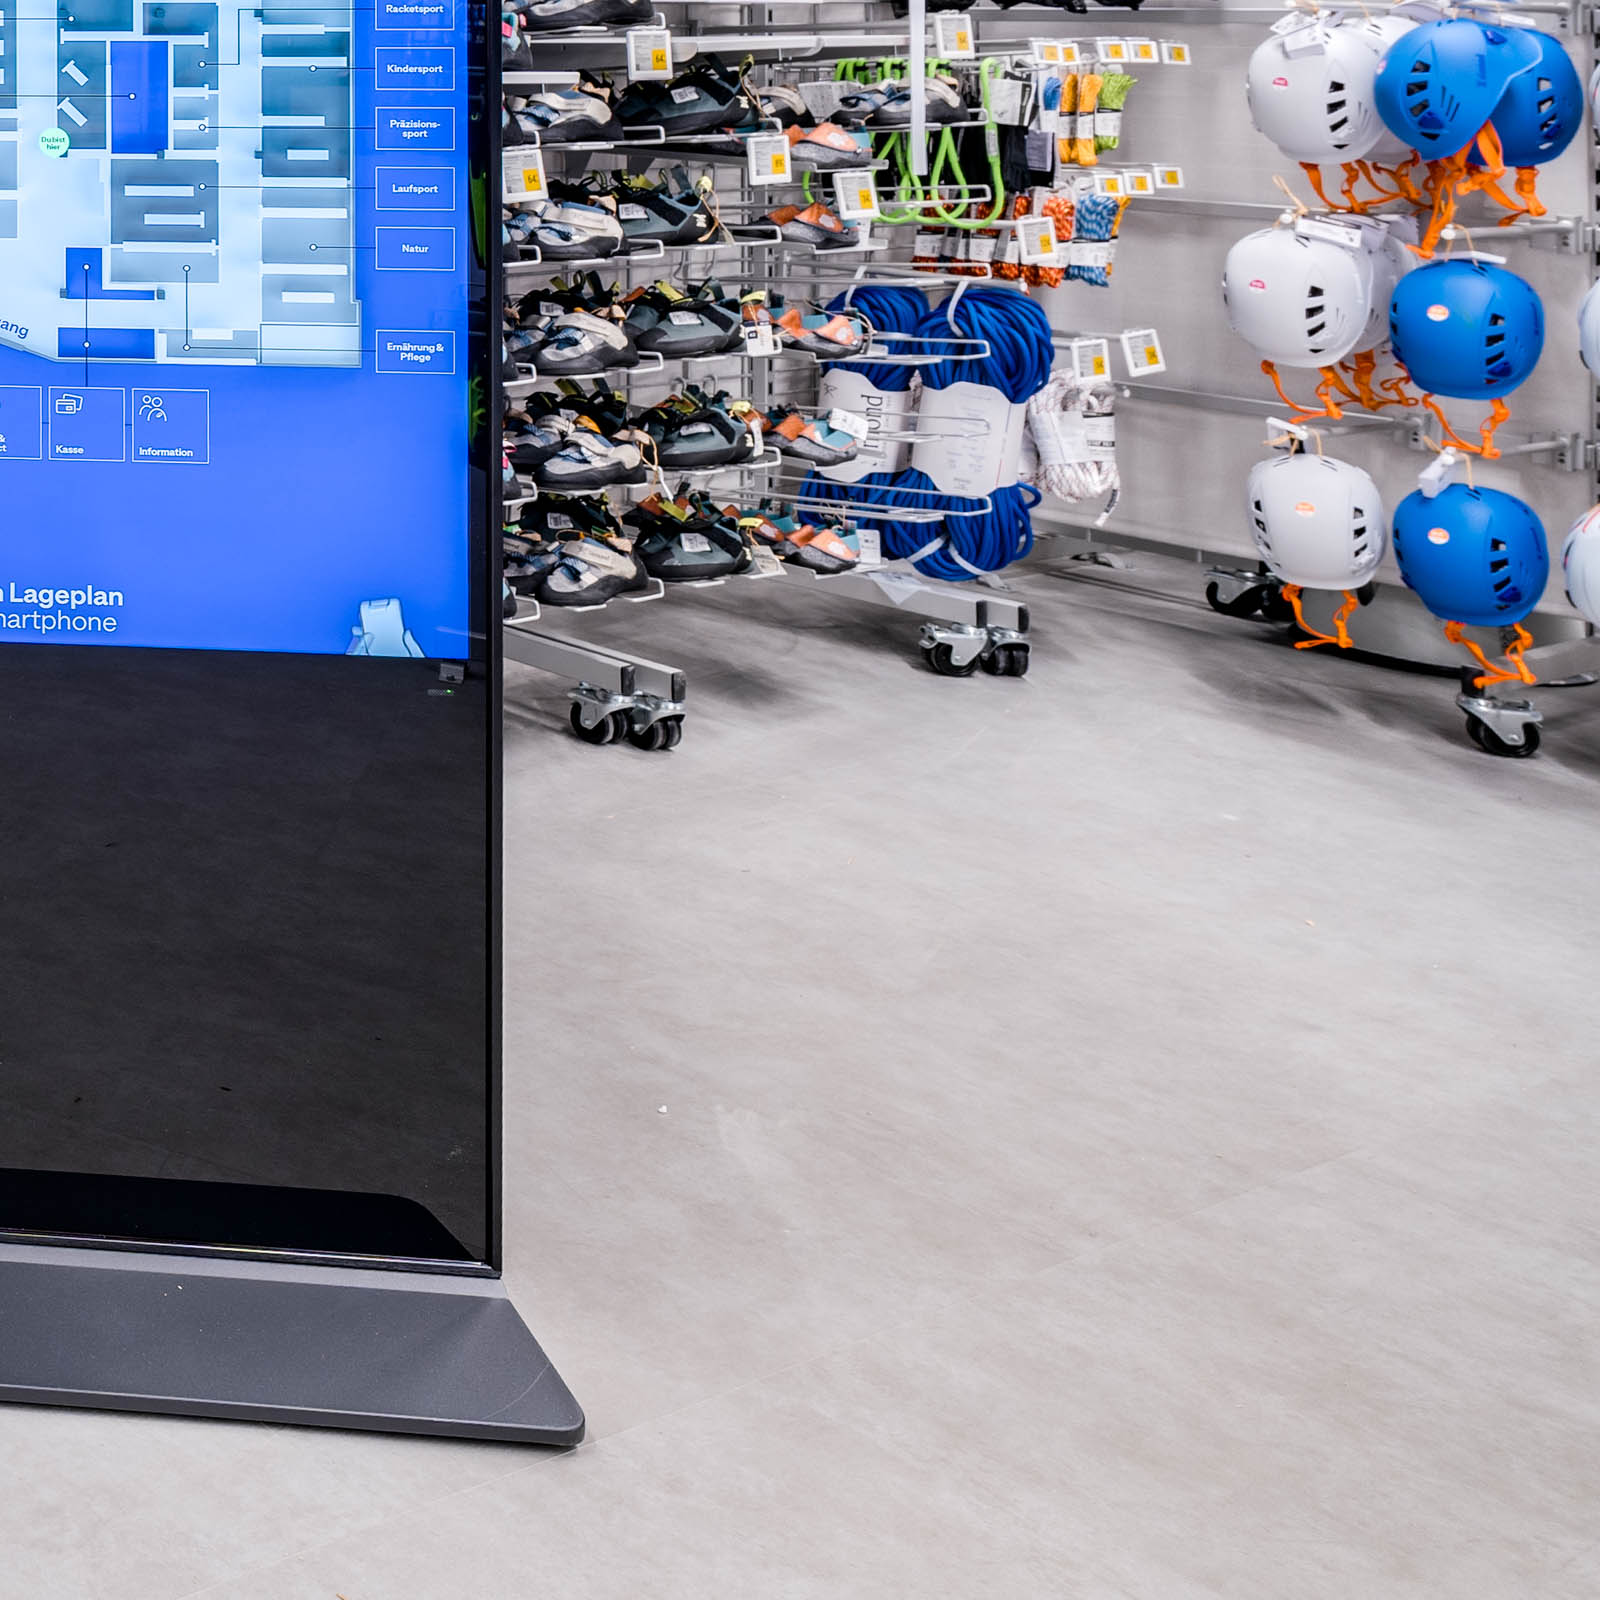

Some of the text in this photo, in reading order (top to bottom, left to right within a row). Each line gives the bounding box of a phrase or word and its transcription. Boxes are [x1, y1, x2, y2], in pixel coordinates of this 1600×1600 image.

[386, 4, 444, 15] Racketsport
[386, 63, 443, 74] Kindersport
[390, 119, 441, 129] Präzisions-
[402, 129, 428, 139] sport
[392, 184, 438, 194] Laufsport
[402, 244, 429, 253] Natur
[387, 342, 435, 353] Ernährung
[400, 353, 431, 363] Pflege
[55, 445, 84, 455] Kasse
[139, 447, 194, 457] Information
[9, 582, 124, 610] Lageplan
